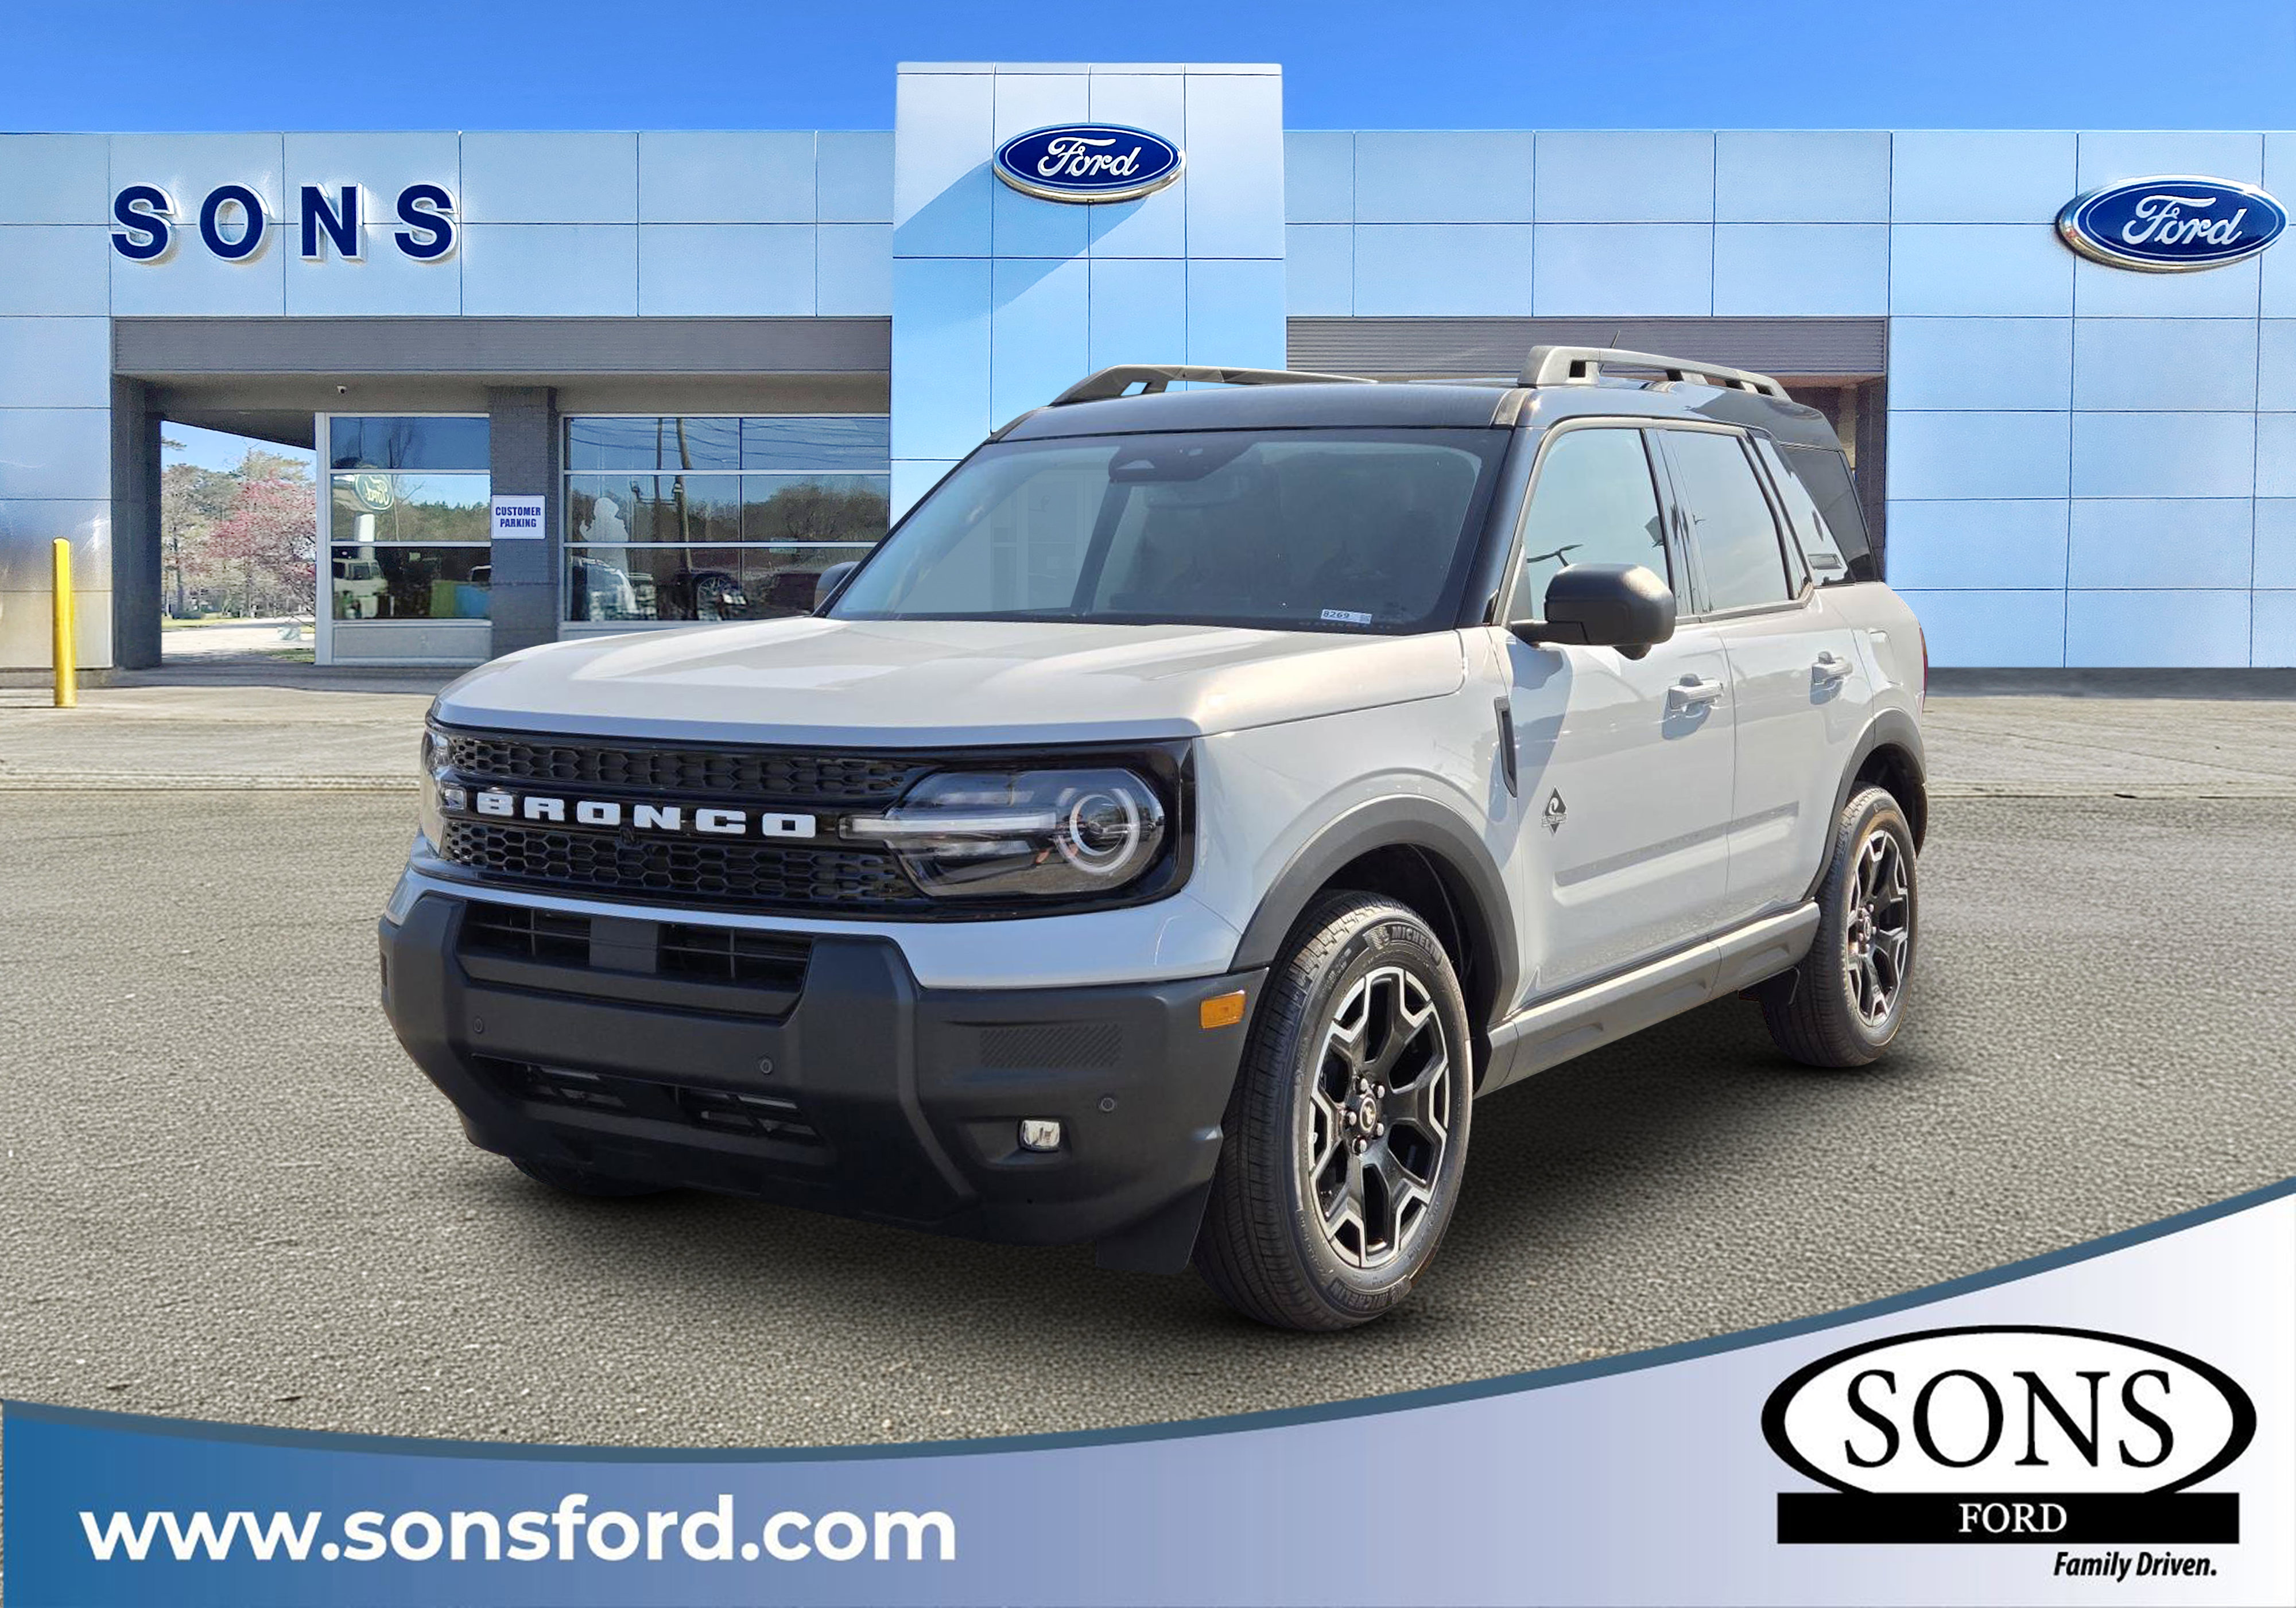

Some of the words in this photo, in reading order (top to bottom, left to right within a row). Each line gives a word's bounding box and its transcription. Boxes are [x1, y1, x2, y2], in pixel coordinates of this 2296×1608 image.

[1037, 137, 1142, 177] Ford
[111, 184, 457, 261] SONS
[2122, 195, 2247, 245] Ford
[495, 507, 541, 515] CUSTOMER
[500, 518, 537, 527] PARKING
[1323, 610, 1349, 618] 8269
[476, 792, 816, 838] BRONCO
[1390, 925, 1443, 965] MICHELIN
